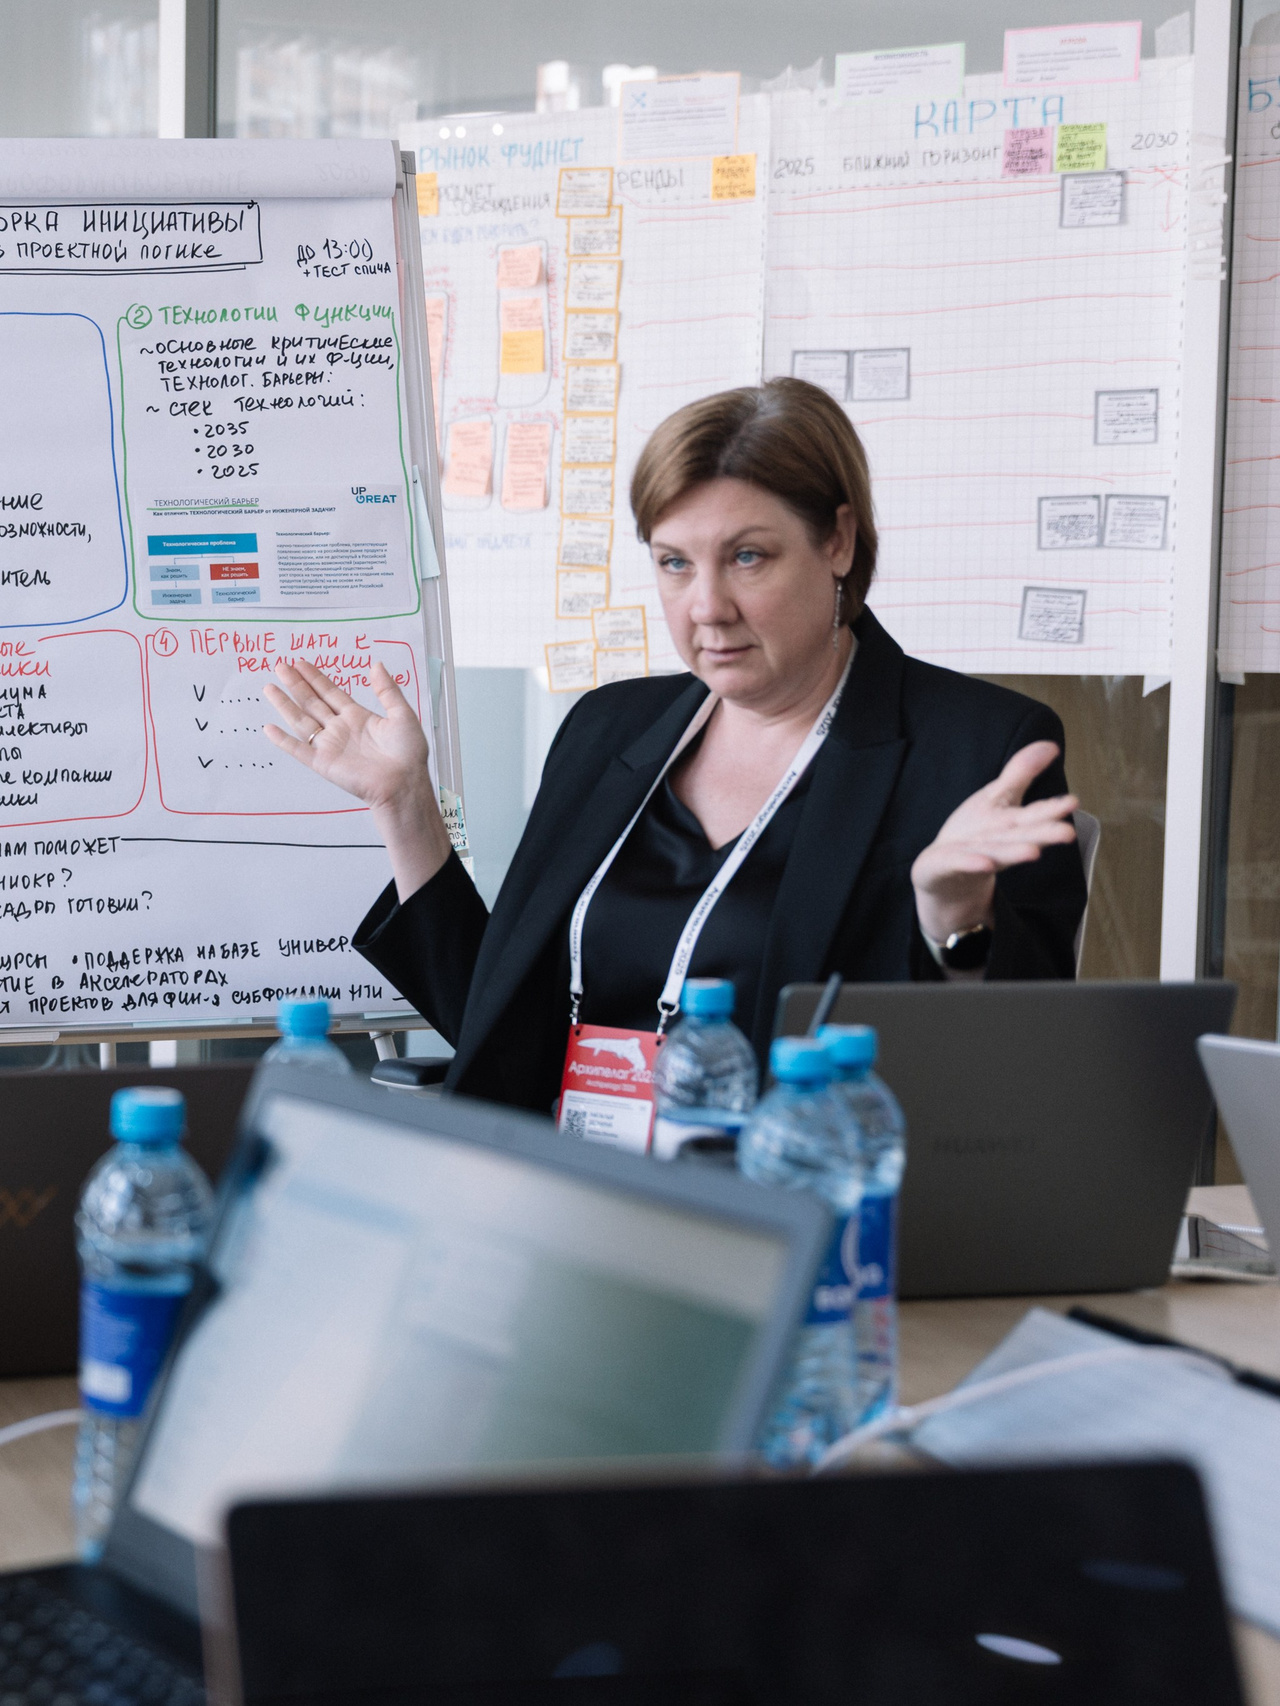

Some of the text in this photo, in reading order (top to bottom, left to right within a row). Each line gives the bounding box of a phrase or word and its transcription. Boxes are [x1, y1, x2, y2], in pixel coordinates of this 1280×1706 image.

[914, 95, 1065, 139] КАРТА
[1131, 131, 1178, 151] 2030
[773, 157, 816, 179] 2025
[842, 150, 910, 173] БЛИЖНИЙ
[921, 146, 1002, 168] ГОРИЗОНТ
[617, 167, 684, 193] РЕНДЫ
[83, 209, 244, 239] ИНИЦИАТИВЫ
[16, 240, 127, 262] ПРОЕКТНОЙ
[296, 238, 374, 266] ДО 13:00
[158, 305, 279, 326] ТЕХНОЛОГИИ
[294, 303, 393, 329] ФУНКЦИИ
[160, 373, 255, 393] ТЕХНОЛОГ.
[204, 420, 251, 438] 2035
[207, 443, 255, 460] 2030
[212, 462, 260, 480] 2025
[351, 486, 367, 495] UP
[356, 495, 398, 505] GREAT
[154, 497, 260, 507] ТЕХНОЛОГИЧЕСКИЙ БАРЬЕР
[190, 628, 277, 656] ПЕРВЫЕ
[34, 836, 121, 856] ПОМОЖЕТ
[84, 947, 185, 973] ПОДДЕРЖКА
[28, 995, 114, 1015] ПРОЕКТОВ
[348, 983, 383, 1001] НТИ
[568, 1060, 630, 1080] Архипелаг
